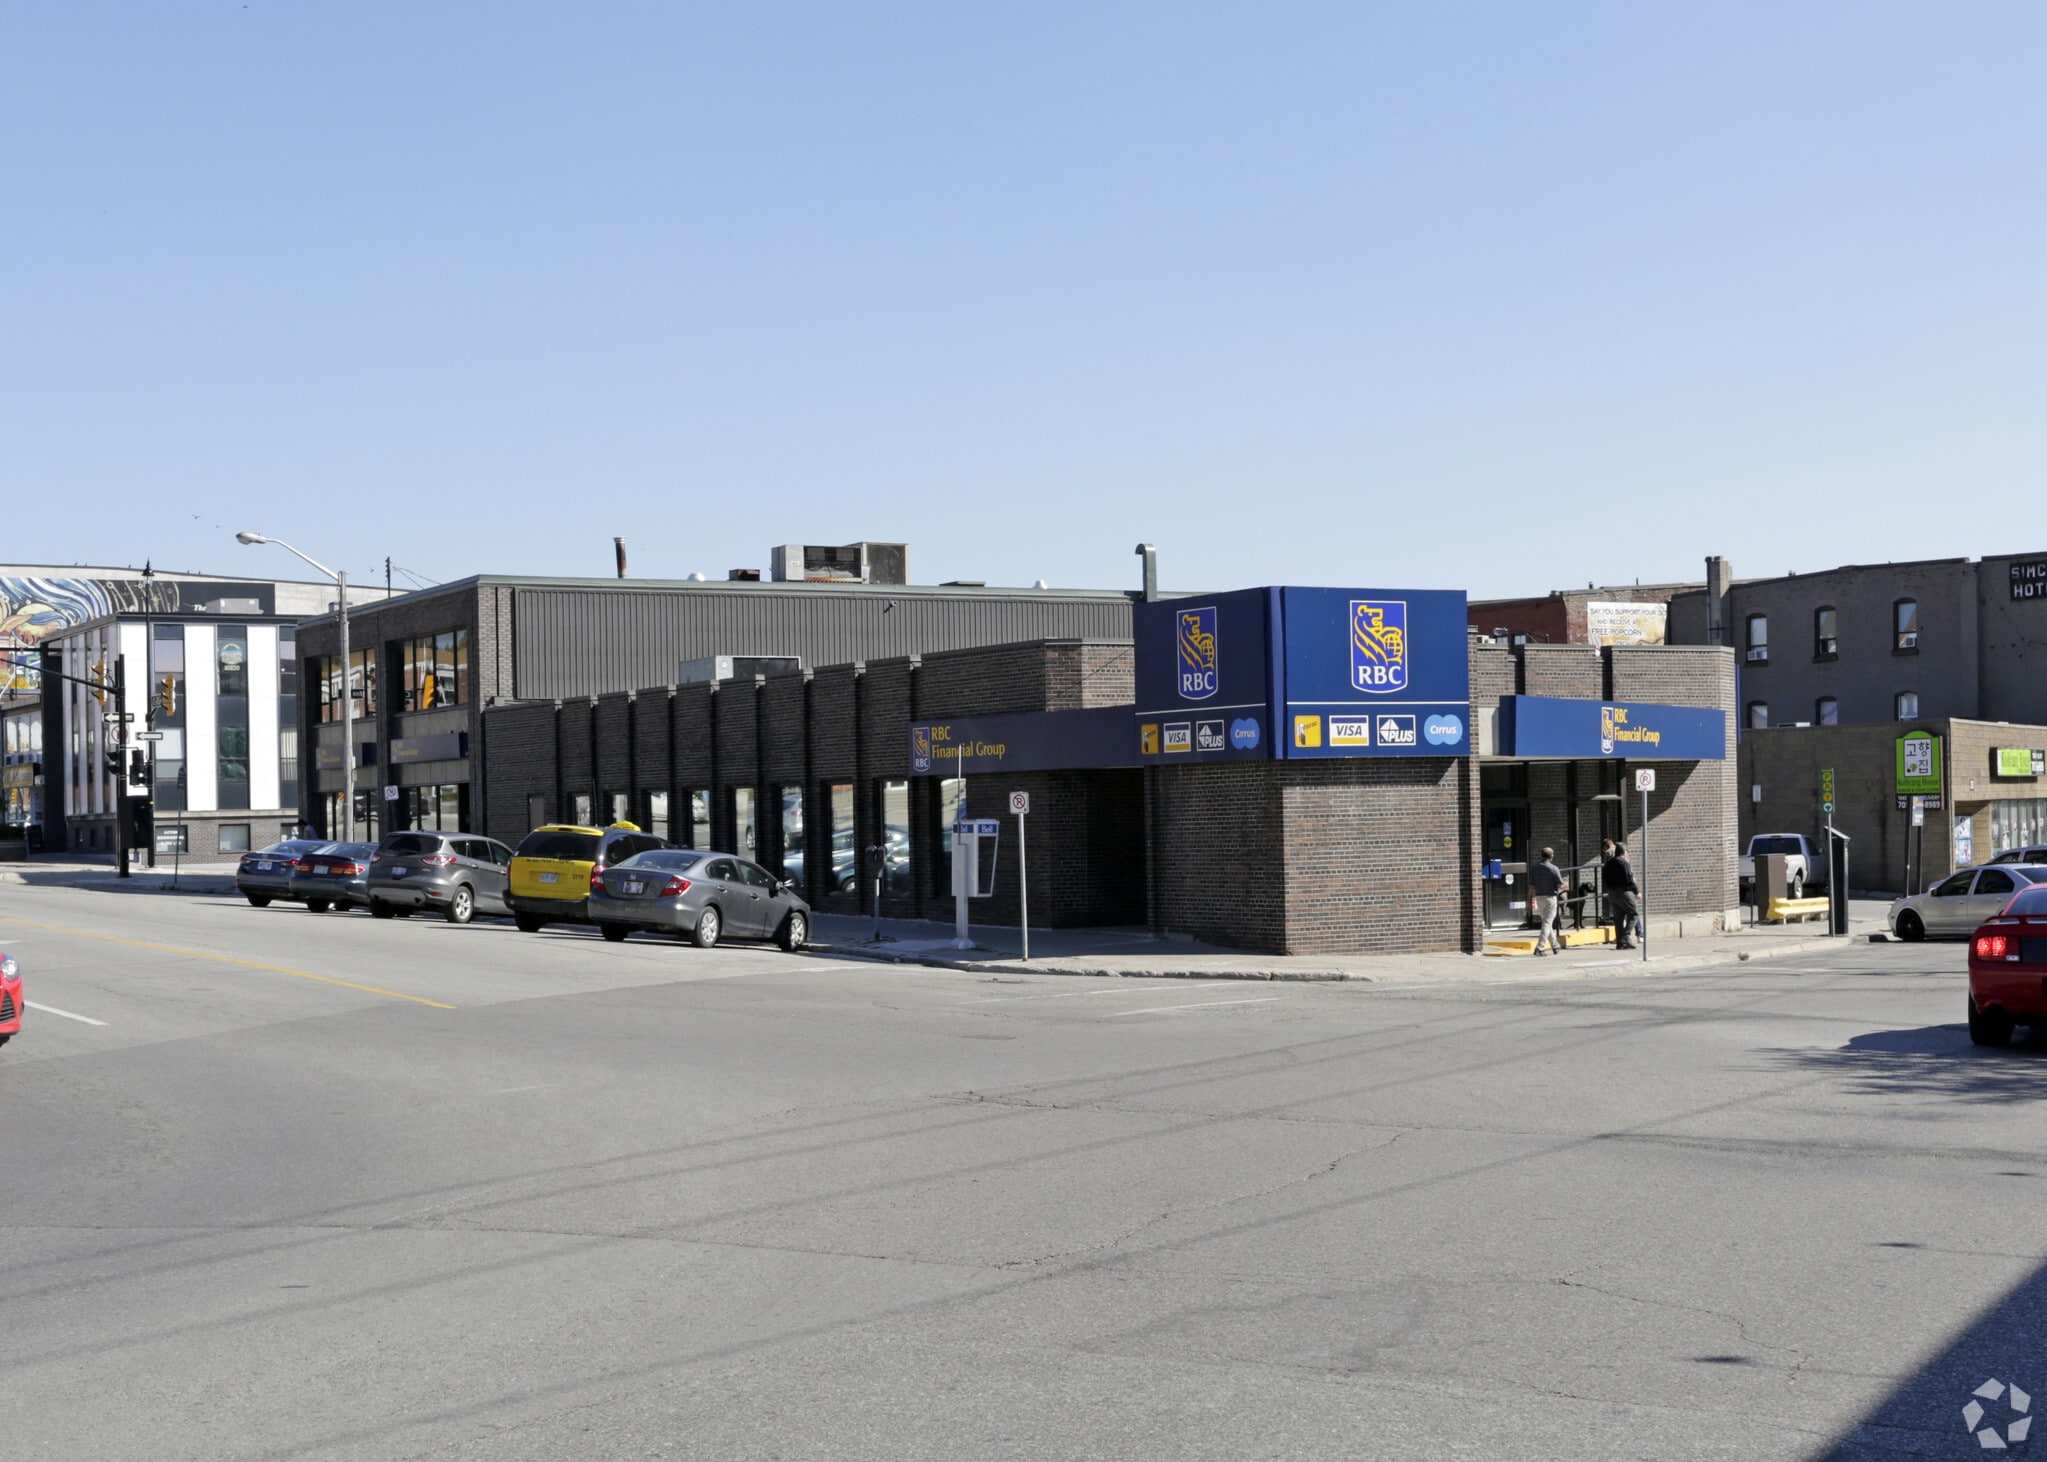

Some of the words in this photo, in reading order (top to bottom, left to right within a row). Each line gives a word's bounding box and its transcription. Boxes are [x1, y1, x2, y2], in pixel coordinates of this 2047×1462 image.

[1615, 608, 1640, 616] SUPPORT
[1591, 628, 1608, 636] FREE
[1610, 628, 1642, 636] POPCORN
[1183, 672, 1214, 692] RBC
[1358, 665, 1402, 685] RBC
[1614, 708, 1628, 724] RBC
[931, 726, 951, 741] RBC
[1234, 729, 1256, 739] Cirrus
[1336, 725, 1362, 736] VISA
[1391, 730, 1414, 742] PLUS
[1429, 725, 1457, 735] Cirrus
[1614, 726, 1641, 742] Financial
[1642, 728, 1660, 747] Group
[1168, 731, 1186, 744] VISA
[1204, 734, 1223, 748] PLUS
[976, 742, 1006, 760] Group
[1906, 741, 1930, 757] 고향
[915, 758, 929, 768] RBC
[1918, 759, 1928, 774] 집
